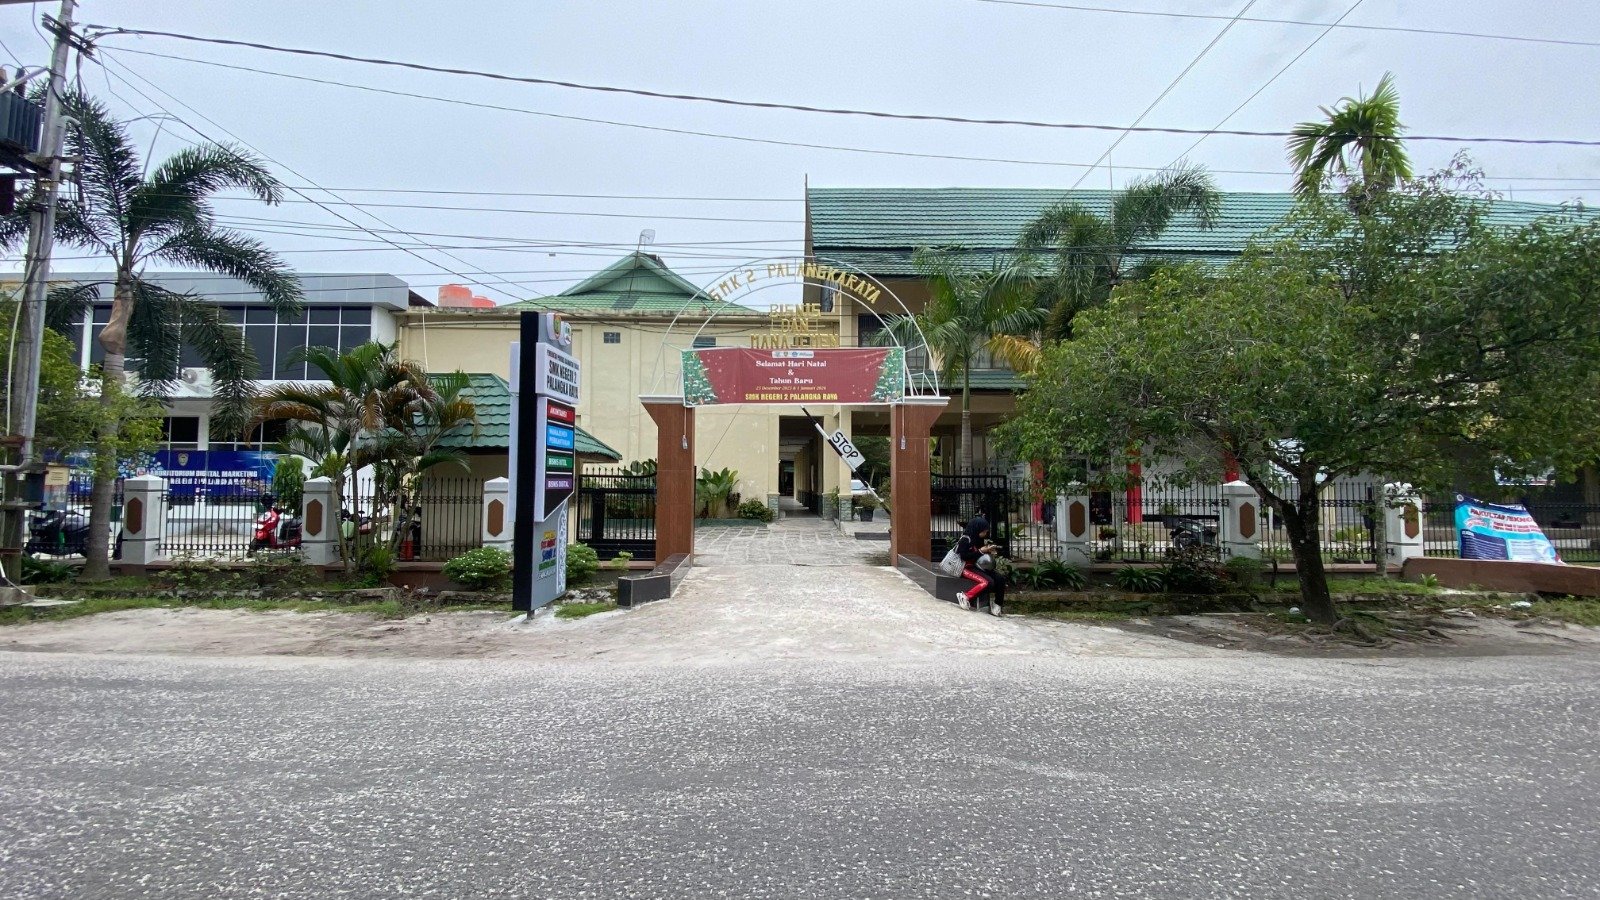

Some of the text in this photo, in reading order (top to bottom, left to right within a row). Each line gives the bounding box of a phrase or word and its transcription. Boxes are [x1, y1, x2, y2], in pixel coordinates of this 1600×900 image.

[745, 268, 757, 284] 2
[781, 318, 809, 333] DAN
[750, 333, 840, 349] MANAJEMEN
[832, 432, 858, 458] STOP
